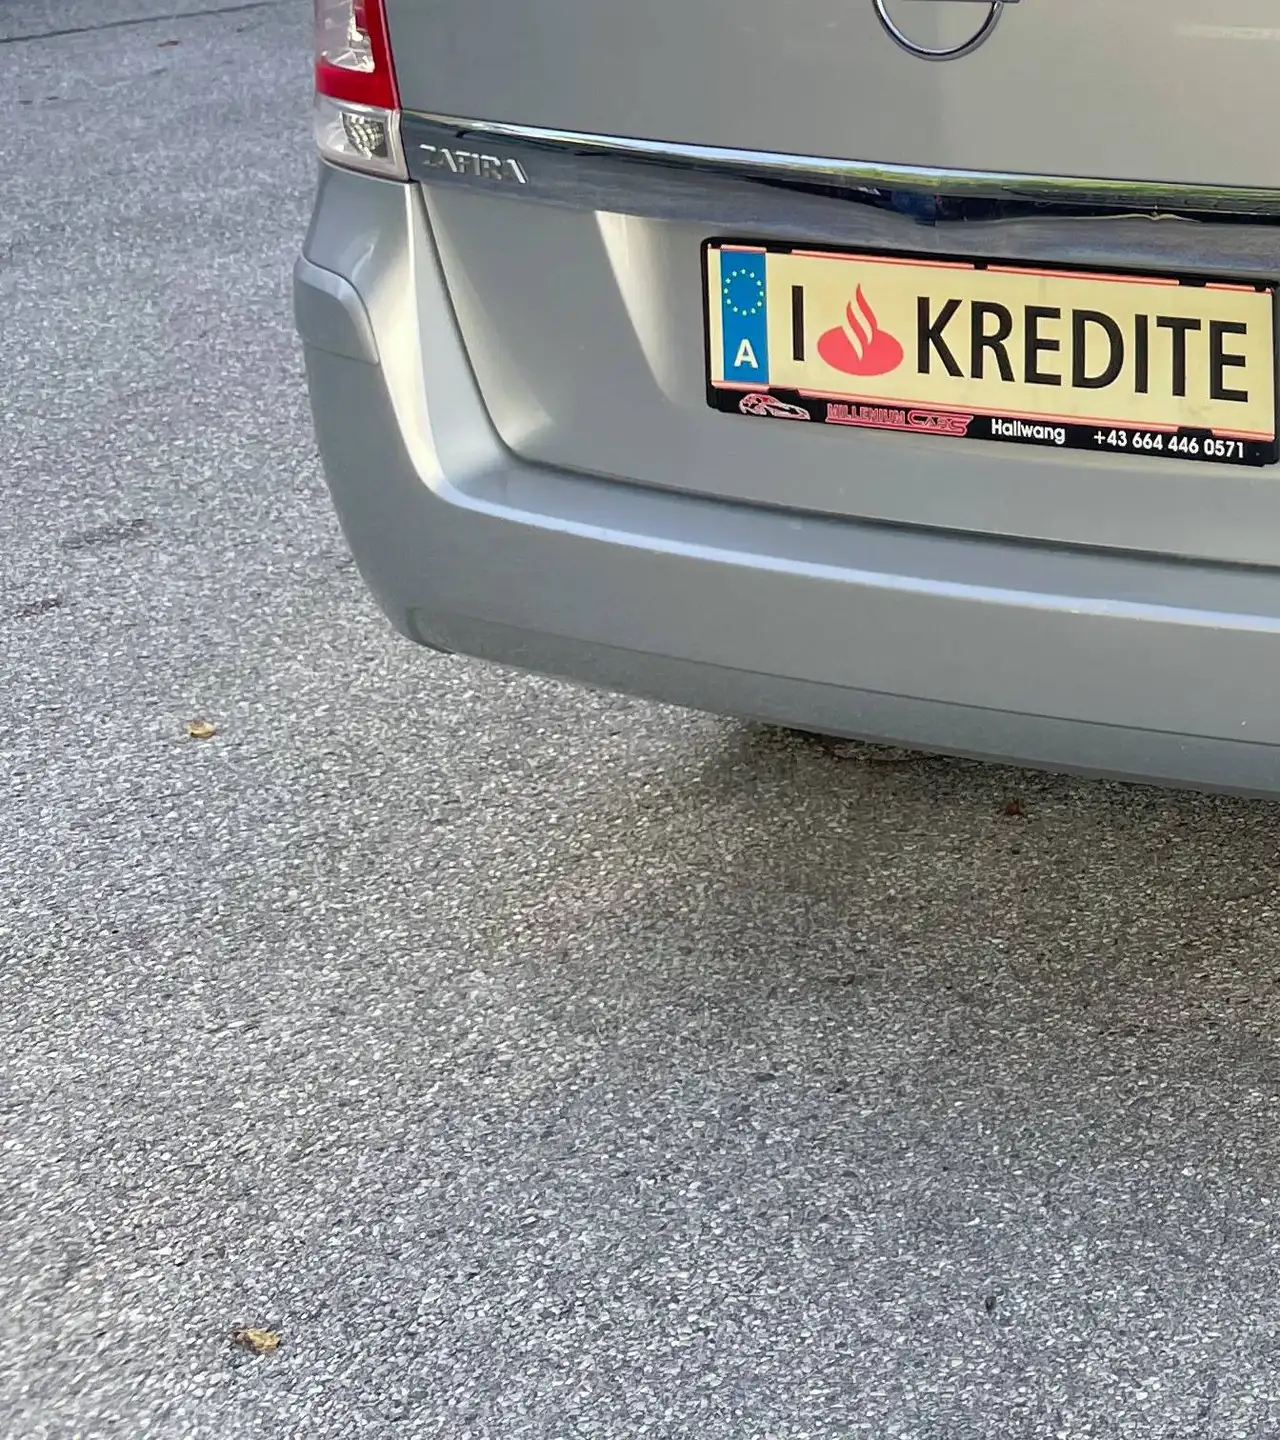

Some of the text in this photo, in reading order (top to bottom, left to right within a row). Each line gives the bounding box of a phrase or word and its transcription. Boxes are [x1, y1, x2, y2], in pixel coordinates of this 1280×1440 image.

[733, 338, 759, 370] A
[792, 285, 1249, 403] I KREDITE
[991, 419, 1066, 445] Hallwang
[1093, 430, 1128, 448] +43
[1131, 432, 1164, 451] 664
[1167, 435, 1200, 455] 446
[1203, 440, 1245, 459] 0571
